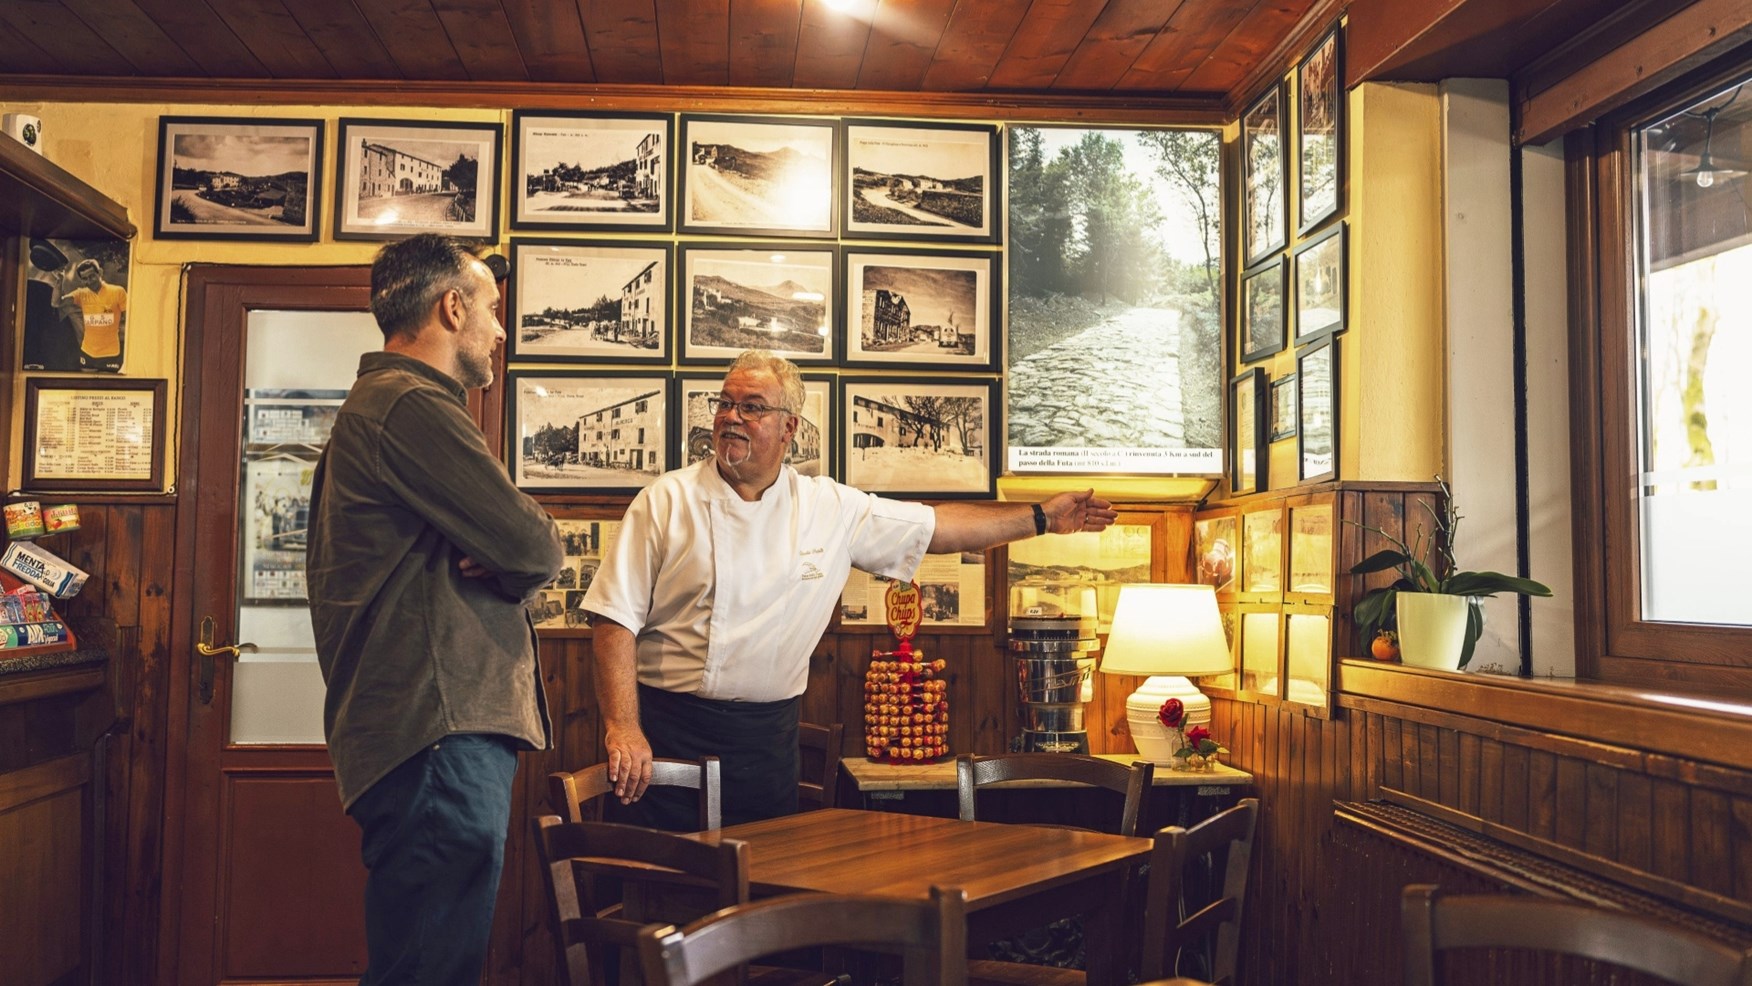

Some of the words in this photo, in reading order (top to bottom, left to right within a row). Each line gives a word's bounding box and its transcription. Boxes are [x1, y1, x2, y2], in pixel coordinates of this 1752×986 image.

[12, 560, 41, 580] FREDDA
[17, 552, 45, 571] MENTA
[891, 592, 916, 608] Chupa
[890, 606, 916, 622] Chups
